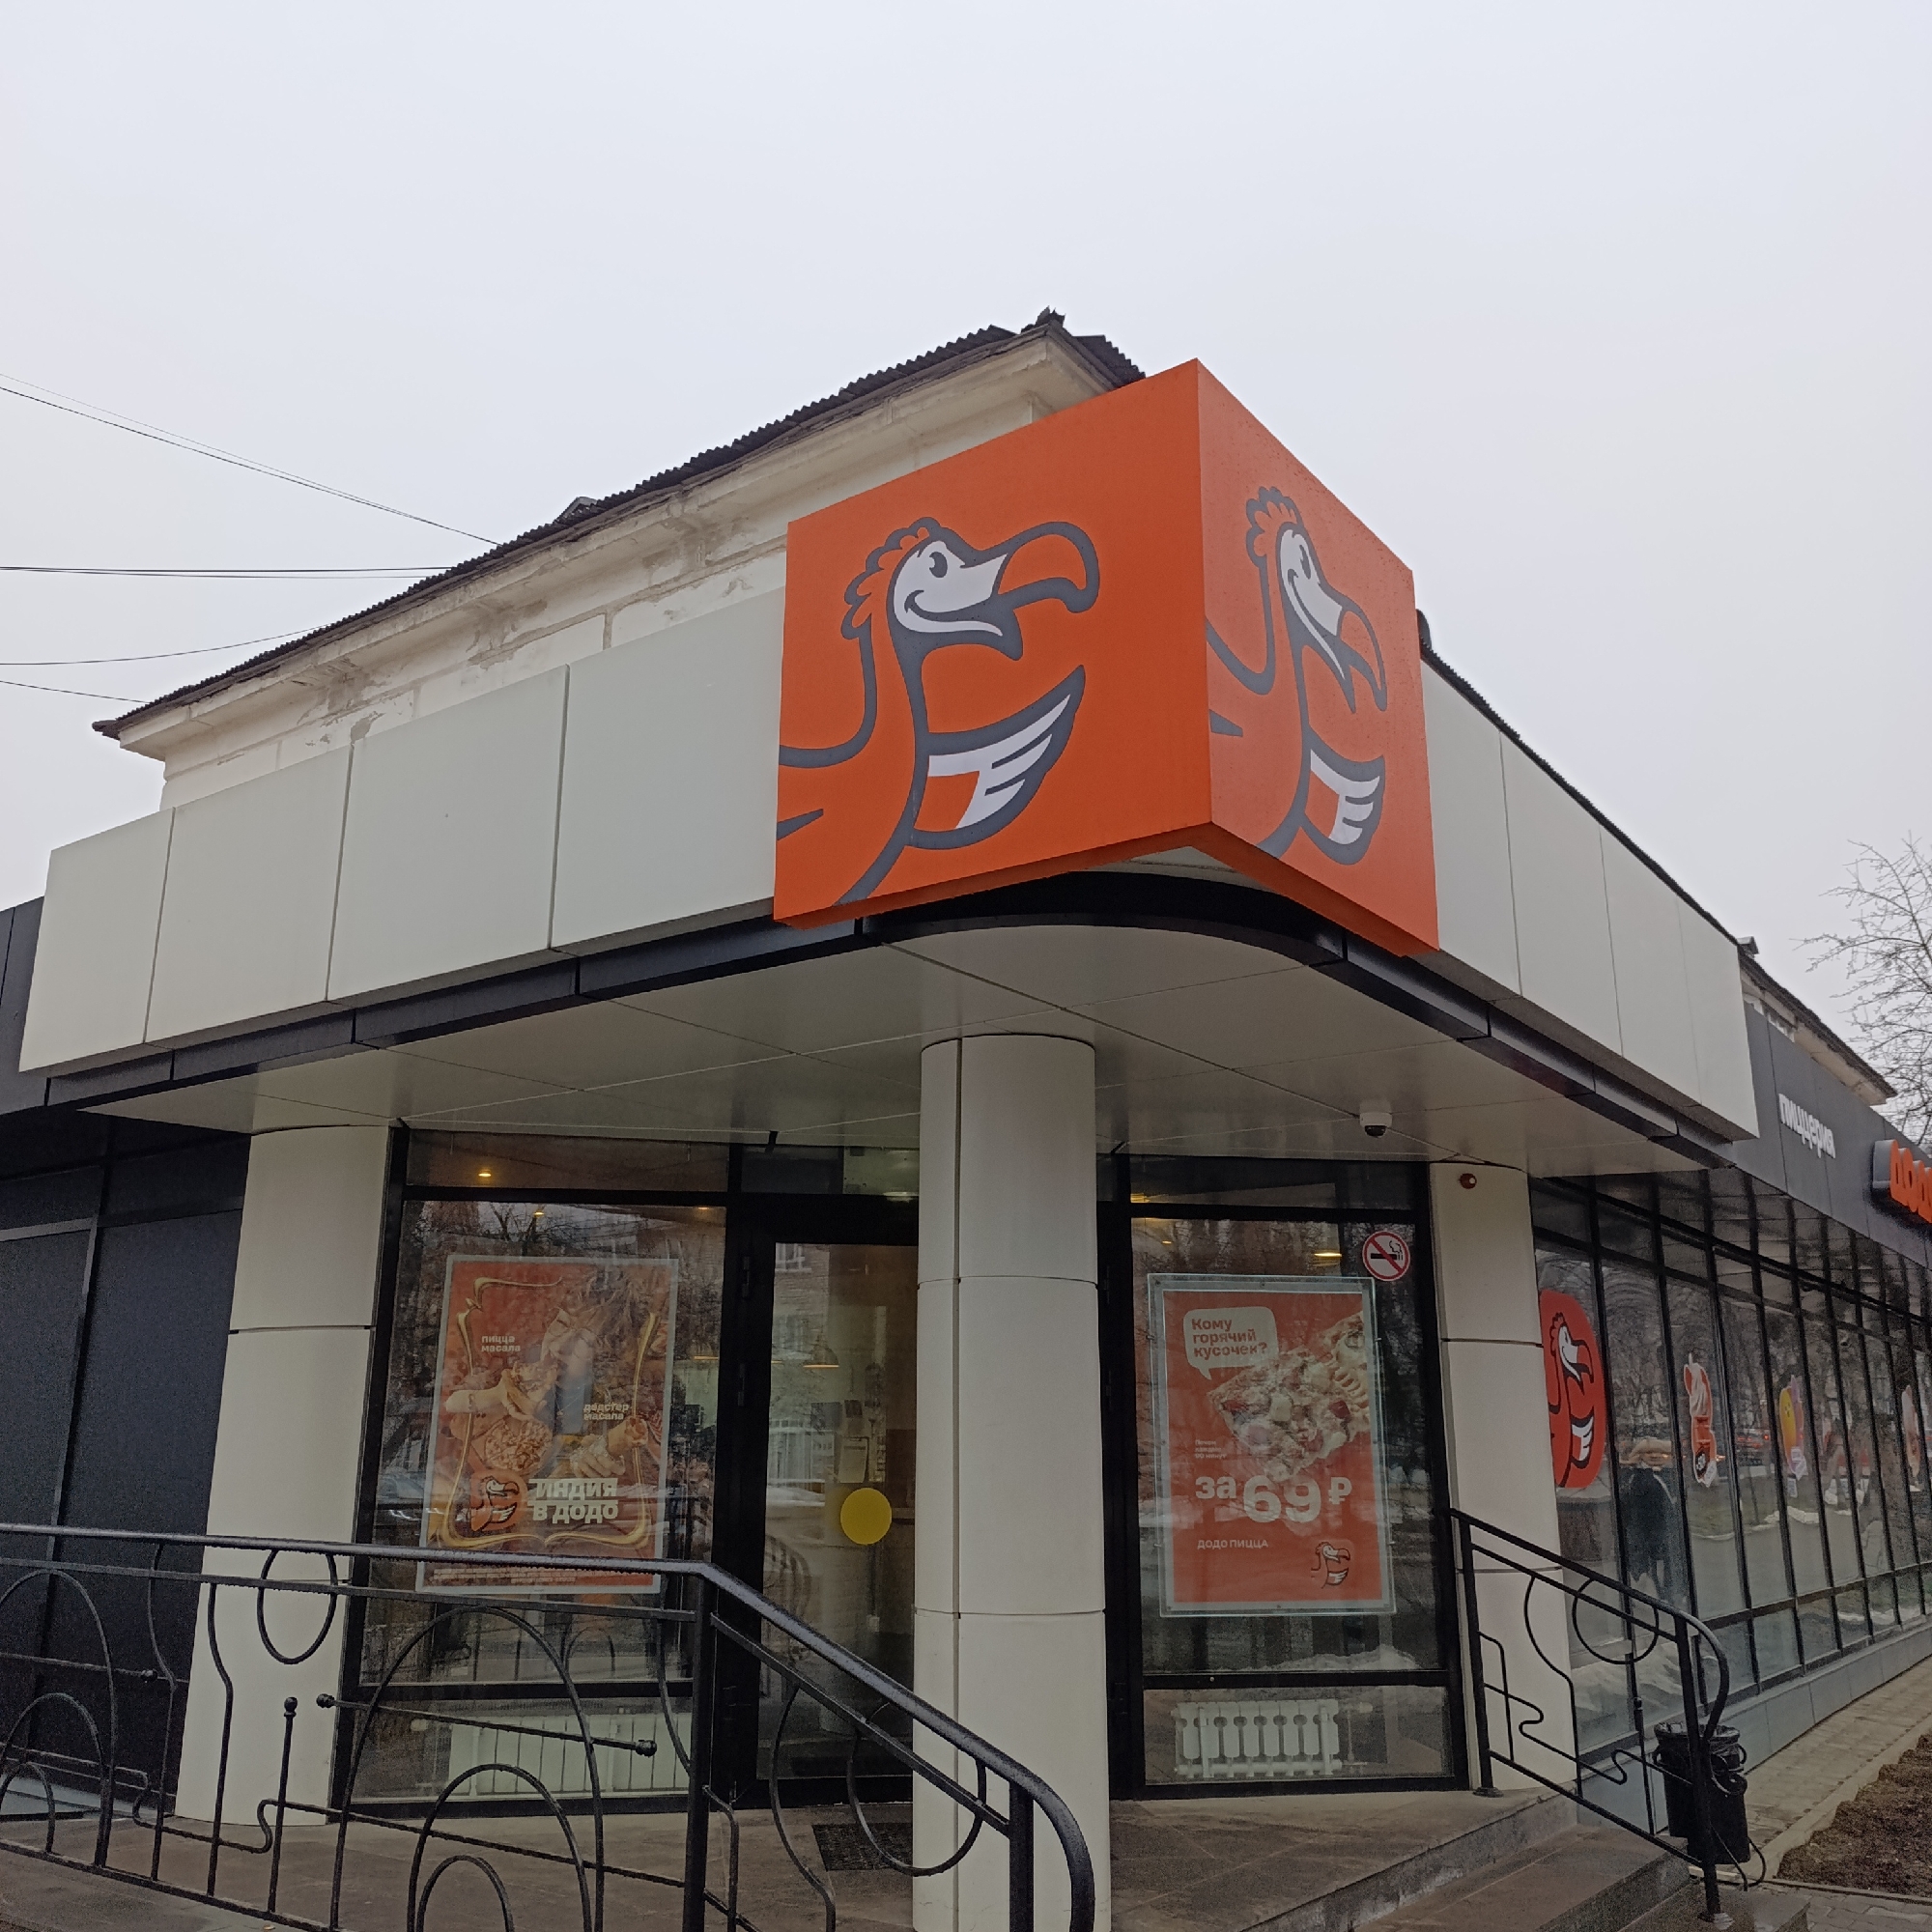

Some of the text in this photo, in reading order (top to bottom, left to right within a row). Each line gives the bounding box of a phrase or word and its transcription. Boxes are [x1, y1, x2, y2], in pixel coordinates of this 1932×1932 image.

[1191, 1319, 1232, 1332] Кому
[481, 1335, 515, 1344] пицца
[1193, 1328, 1257, 1346] горячий
[1193, 1342, 1267, 1360] кусочек?
[1243, 1475, 1321, 1523] 69
